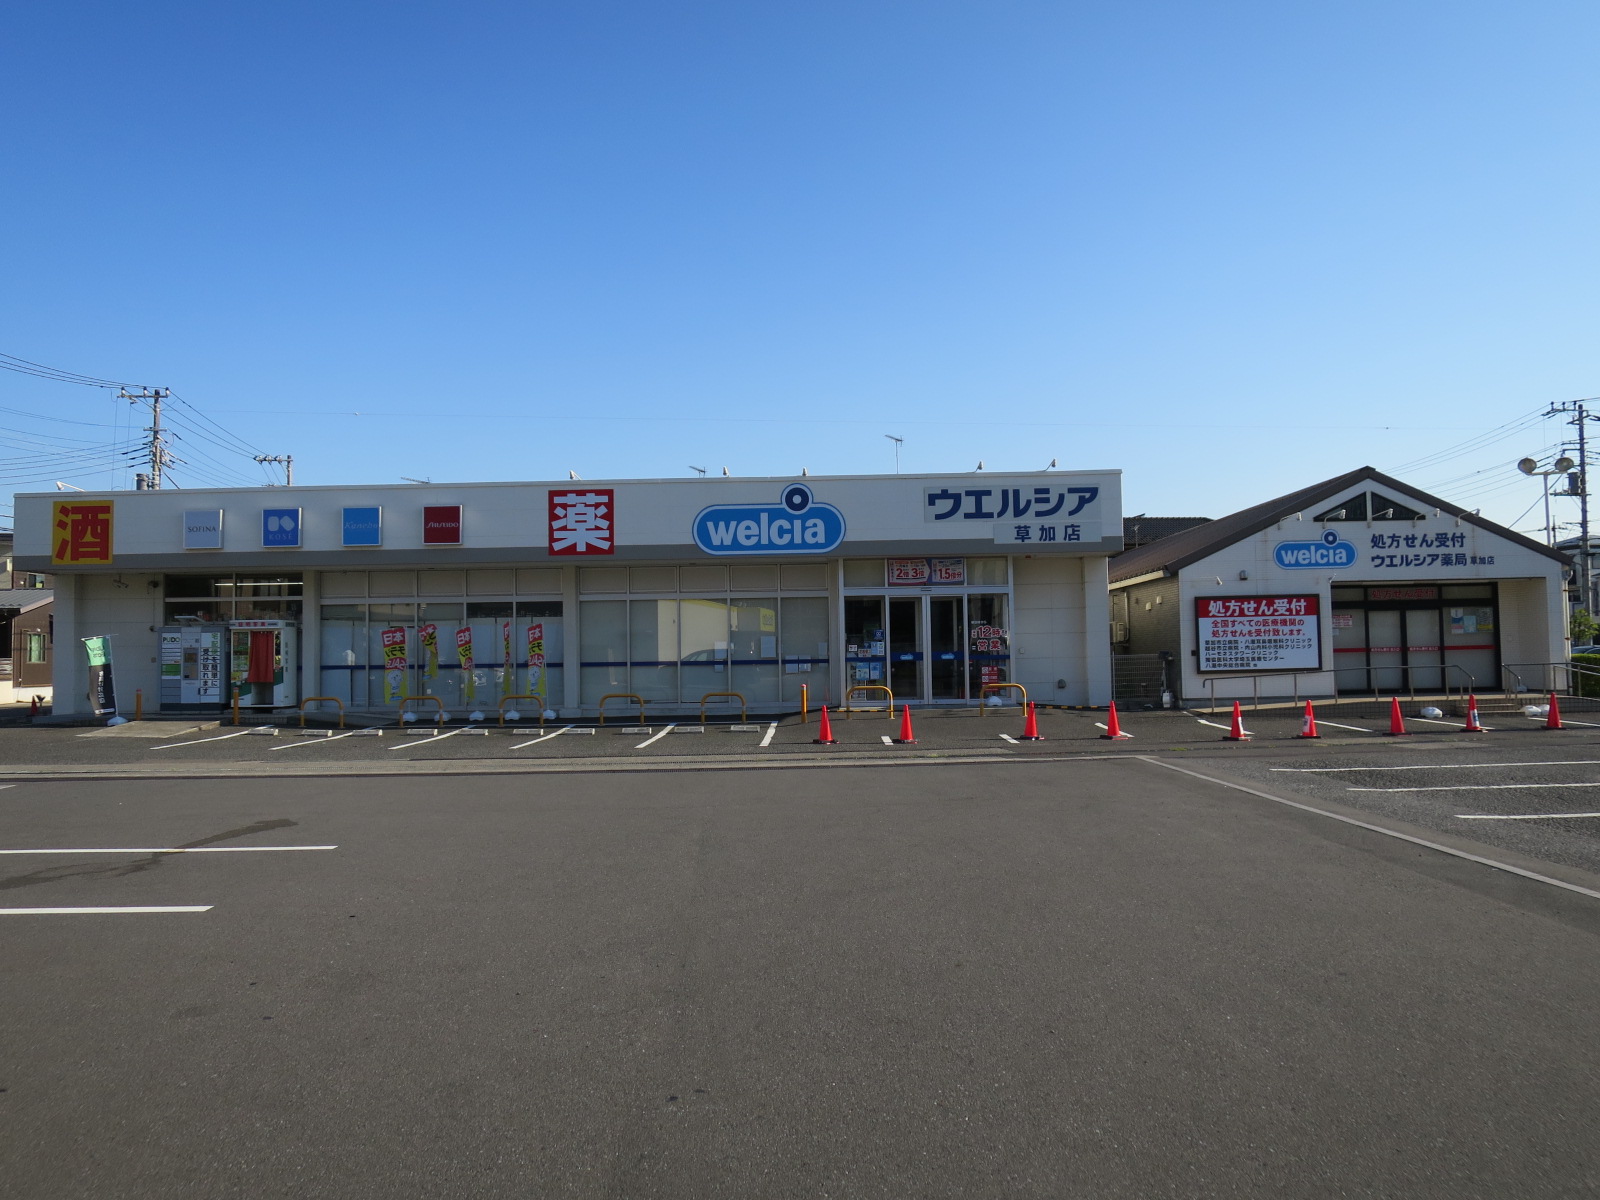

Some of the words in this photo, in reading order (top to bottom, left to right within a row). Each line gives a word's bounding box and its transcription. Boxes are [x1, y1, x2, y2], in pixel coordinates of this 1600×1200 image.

[927, 486, 1099, 520] ウエルシア
[187, 525, 217, 533] SOFINA
[344, 521, 378, 530] Kanebo
[426, 521, 459, 529] SHISEIDO
[551, 493, 611, 552] 薬
[706, 511, 826, 546] welcia
[56, 505, 111, 562] 酒
[1013, 523, 1082, 542] 草加店
[1370, 532, 1466, 549] 処方せん受付
[1281, 545, 1347, 565] welcia
[1370, 553, 1468, 567] ウエルシア薬局
[1469, 555, 1495, 566] 草加店
[1371, 588, 1436, 599] 処方せん受付
[1208, 599, 1307, 616] 処方せん受付
[1211, 618, 1305, 629] 全国すべての医療機関の
[1211, 628, 1306, 638] 処方せんを受付致します。
